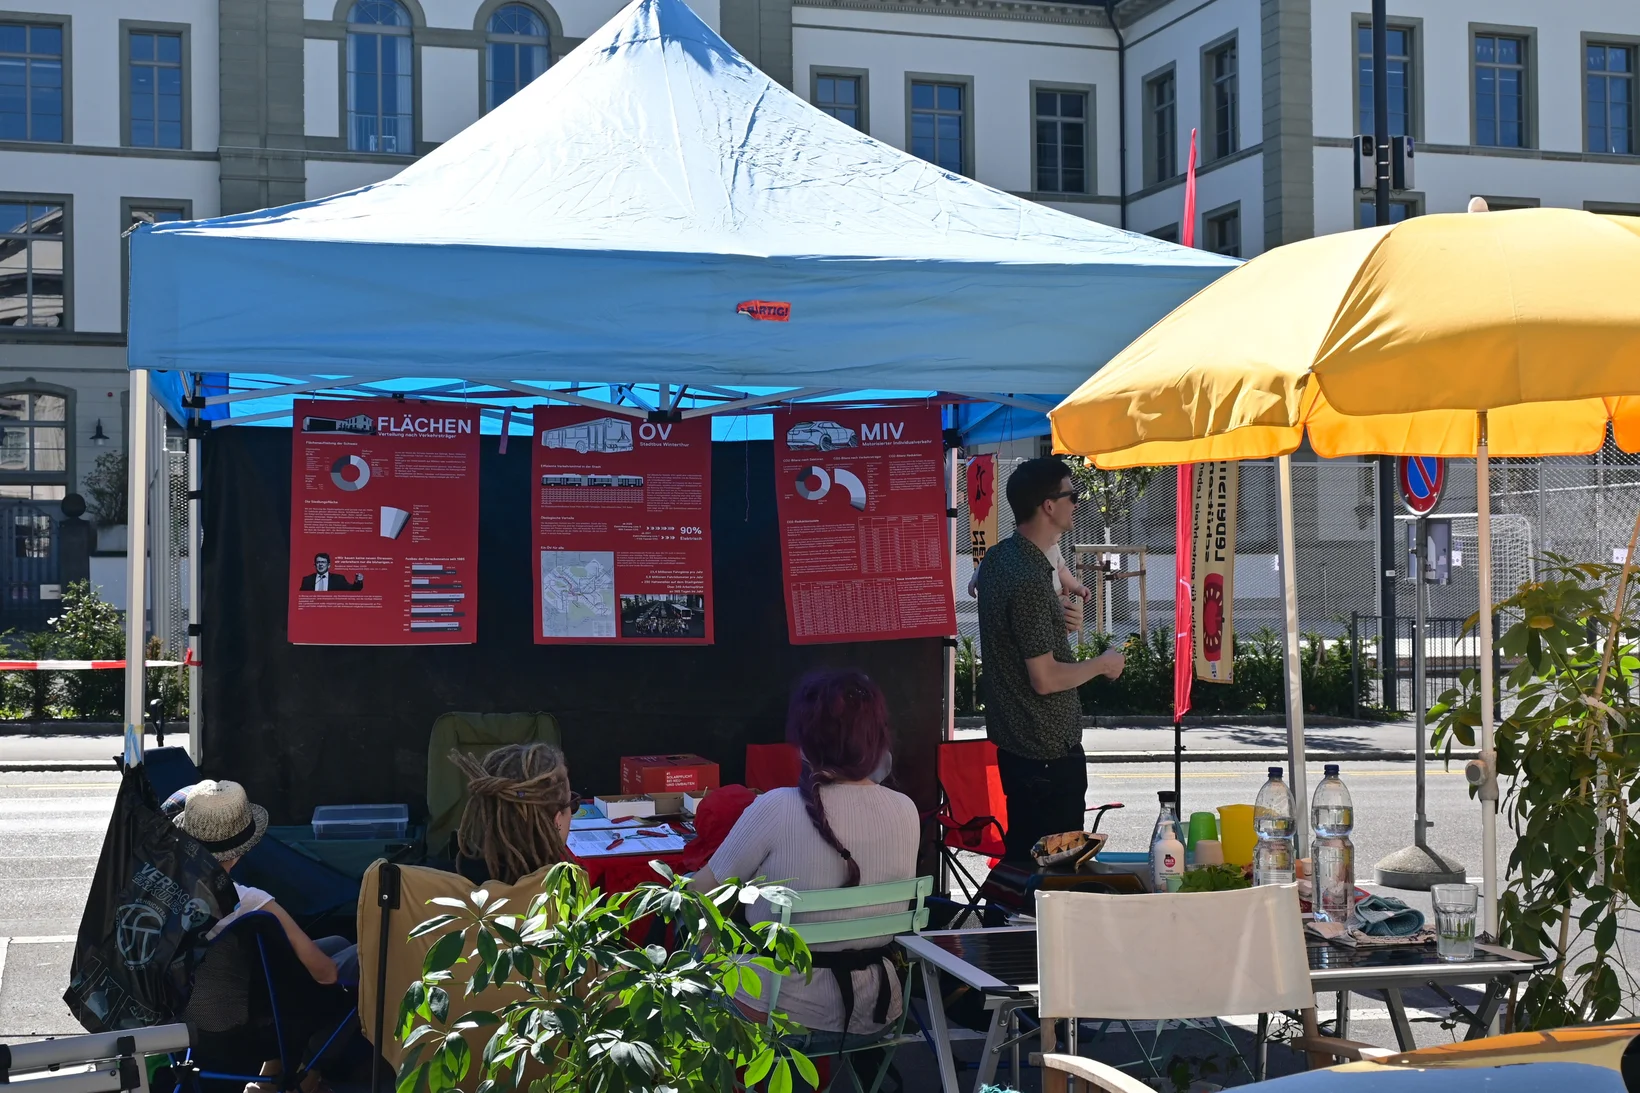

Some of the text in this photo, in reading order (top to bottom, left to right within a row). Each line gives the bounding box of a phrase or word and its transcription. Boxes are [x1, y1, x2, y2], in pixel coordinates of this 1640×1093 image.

[377, 414, 472, 434] FLÄCHEN
[861, 421, 905, 441] MIV
[418, 432, 457, 440] Verkehrsträger
[680, 526, 702, 535] 90%
